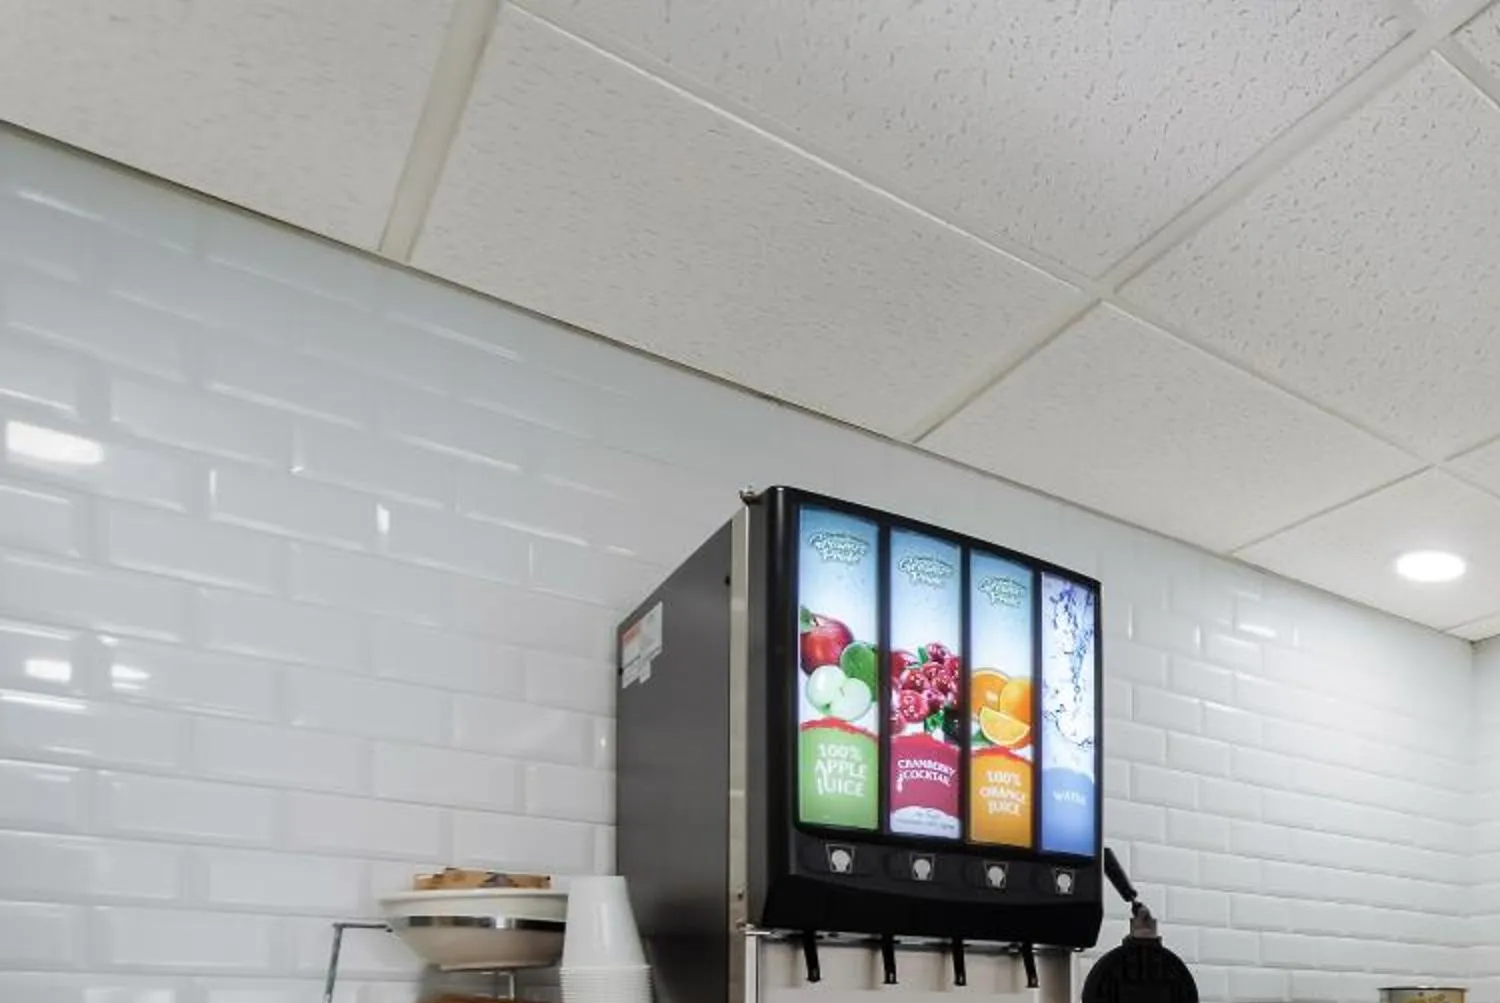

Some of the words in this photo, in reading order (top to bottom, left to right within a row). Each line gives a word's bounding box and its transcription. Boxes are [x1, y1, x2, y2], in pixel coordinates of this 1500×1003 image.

[818, 743, 863, 761] 100%
[815, 759, 868, 779] APPLE
[897, 759, 956, 777] CRANBERRY
[817, 774, 865, 797] JUICE
